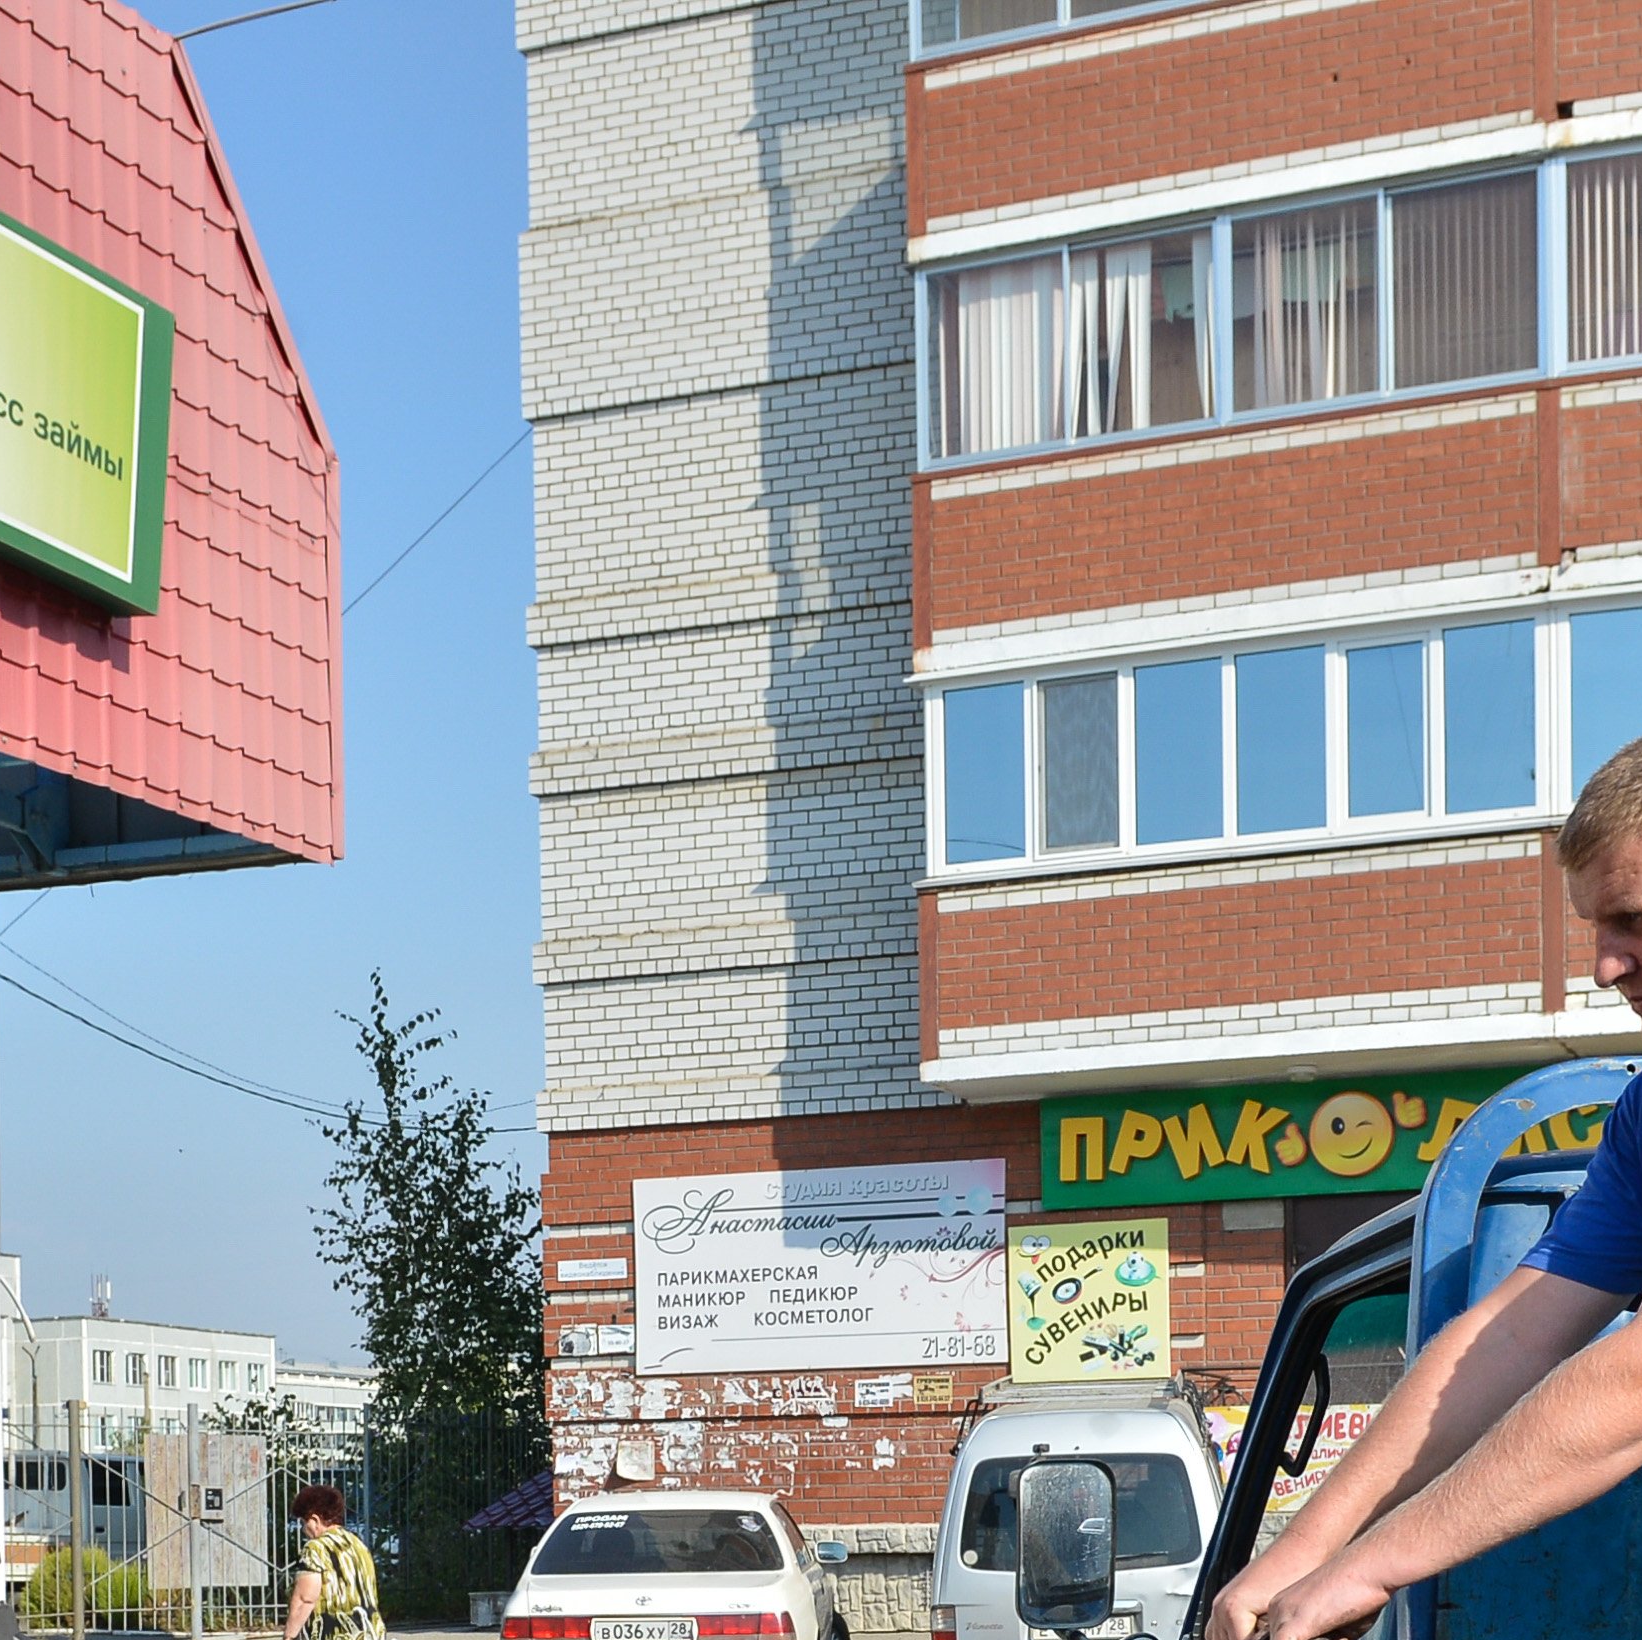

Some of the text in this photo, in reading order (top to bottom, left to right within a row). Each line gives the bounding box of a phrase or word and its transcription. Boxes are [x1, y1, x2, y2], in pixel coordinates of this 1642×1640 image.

[34, 410, 125, 482] займы
[642, 1188, 837, 1255] Анастасии
[1035, 1229, 1145, 1284] подарки
[657, 1265, 818, 1287] ПАРИКМАХЕРСКАЯ
[657, 1286, 859, 1309] МАНИКЮР ПЕДИКЮР
[657, 1307, 875, 1330] ВИЗАЖ КОСМЕТОЛОГ
[1025, 1290, 1149, 1366] СУВЕНИРЫ
[921, 1335, 997, 1359] 21-81-68
[670, 1622, 688, 1636] 28
